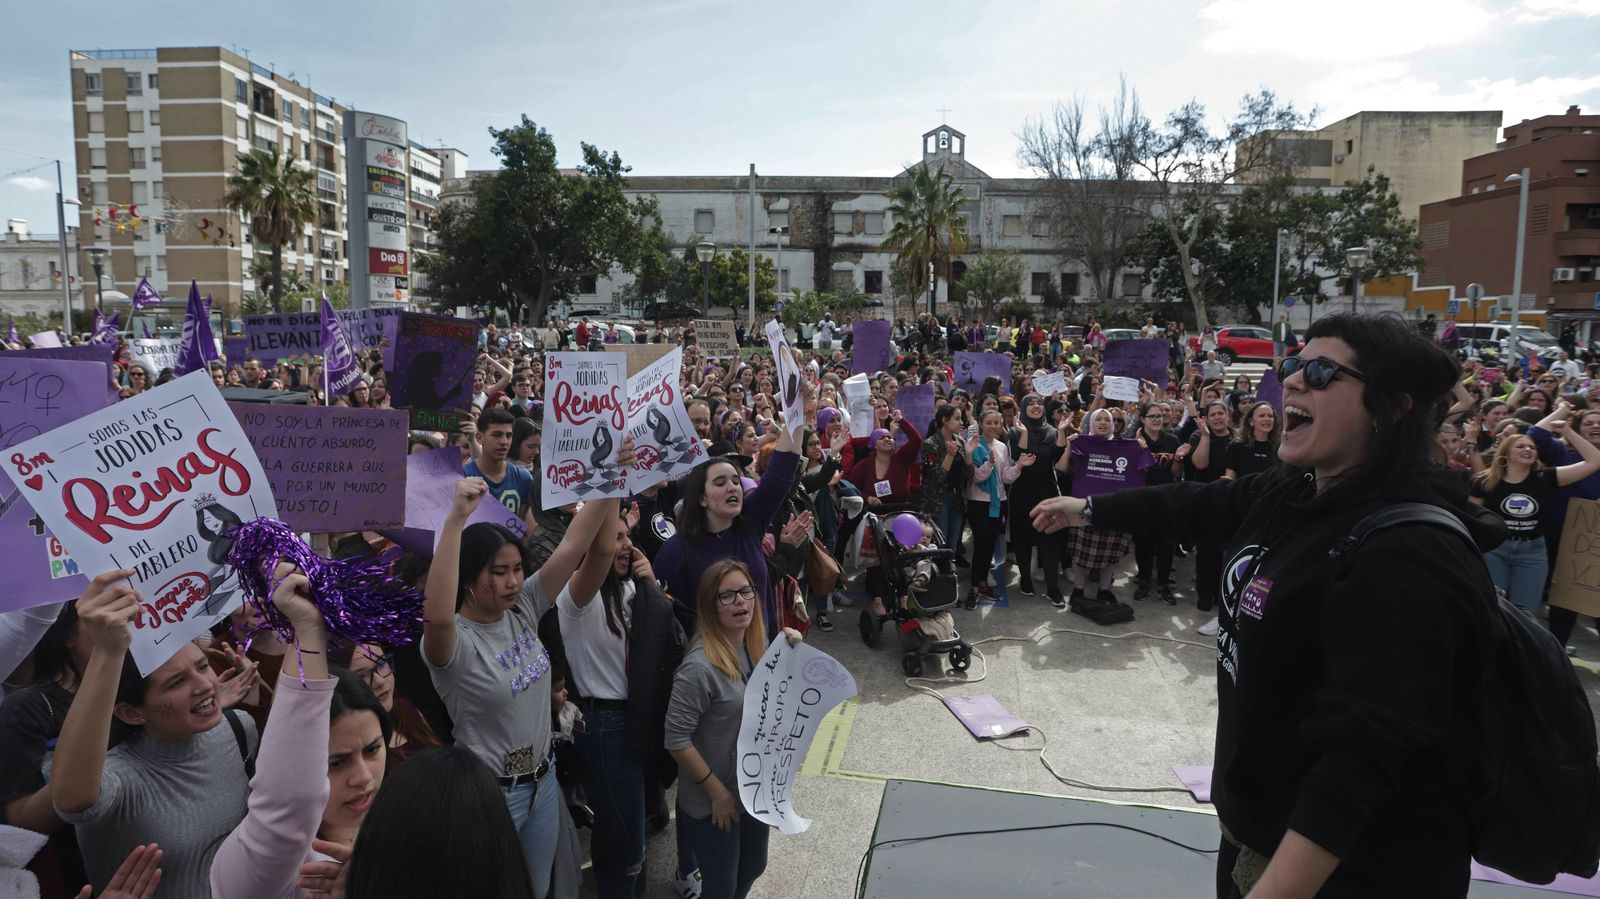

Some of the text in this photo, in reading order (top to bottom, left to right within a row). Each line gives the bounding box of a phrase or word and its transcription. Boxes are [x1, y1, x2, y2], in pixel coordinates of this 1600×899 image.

[251, 327, 321, 351] ¡LEVÁNT
[288, 314, 321, 327] DIGA
[573, 370, 609, 386] JODIDAS
[627, 373, 674, 415] einas
[243, 412, 265, 427] NO
[275, 415, 303, 429] SOY
[304, 417, 323, 430] LA
[389, 419, 401, 429] DE
[552, 380, 625, 431] Reinas
[87, 407, 159, 446] SOMOS LAS
[94, 418, 184, 474] JODIDAS
[262, 435, 317, 449] CUENTO
[322, 437, 377, 451] ABSURDO,
[628, 424, 648, 440] LERO
[61, 427, 252, 545] Reinas
[291, 461, 354, 474] GUERRERA
[362, 460, 385, 473] QUE
[286, 480, 314, 494] POR
[319, 480, 336, 492] UN
[344, 482, 388, 494] MUNDO
[128, 538, 155, 561] DEL
[133, 533, 199, 584] TABLERO
[754, 681, 770, 744] quiero
[764, 675, 793, 755] PIROPO,
[776, 687, 822, 804] RESPETO
[742, 752, 770, 815] NO
